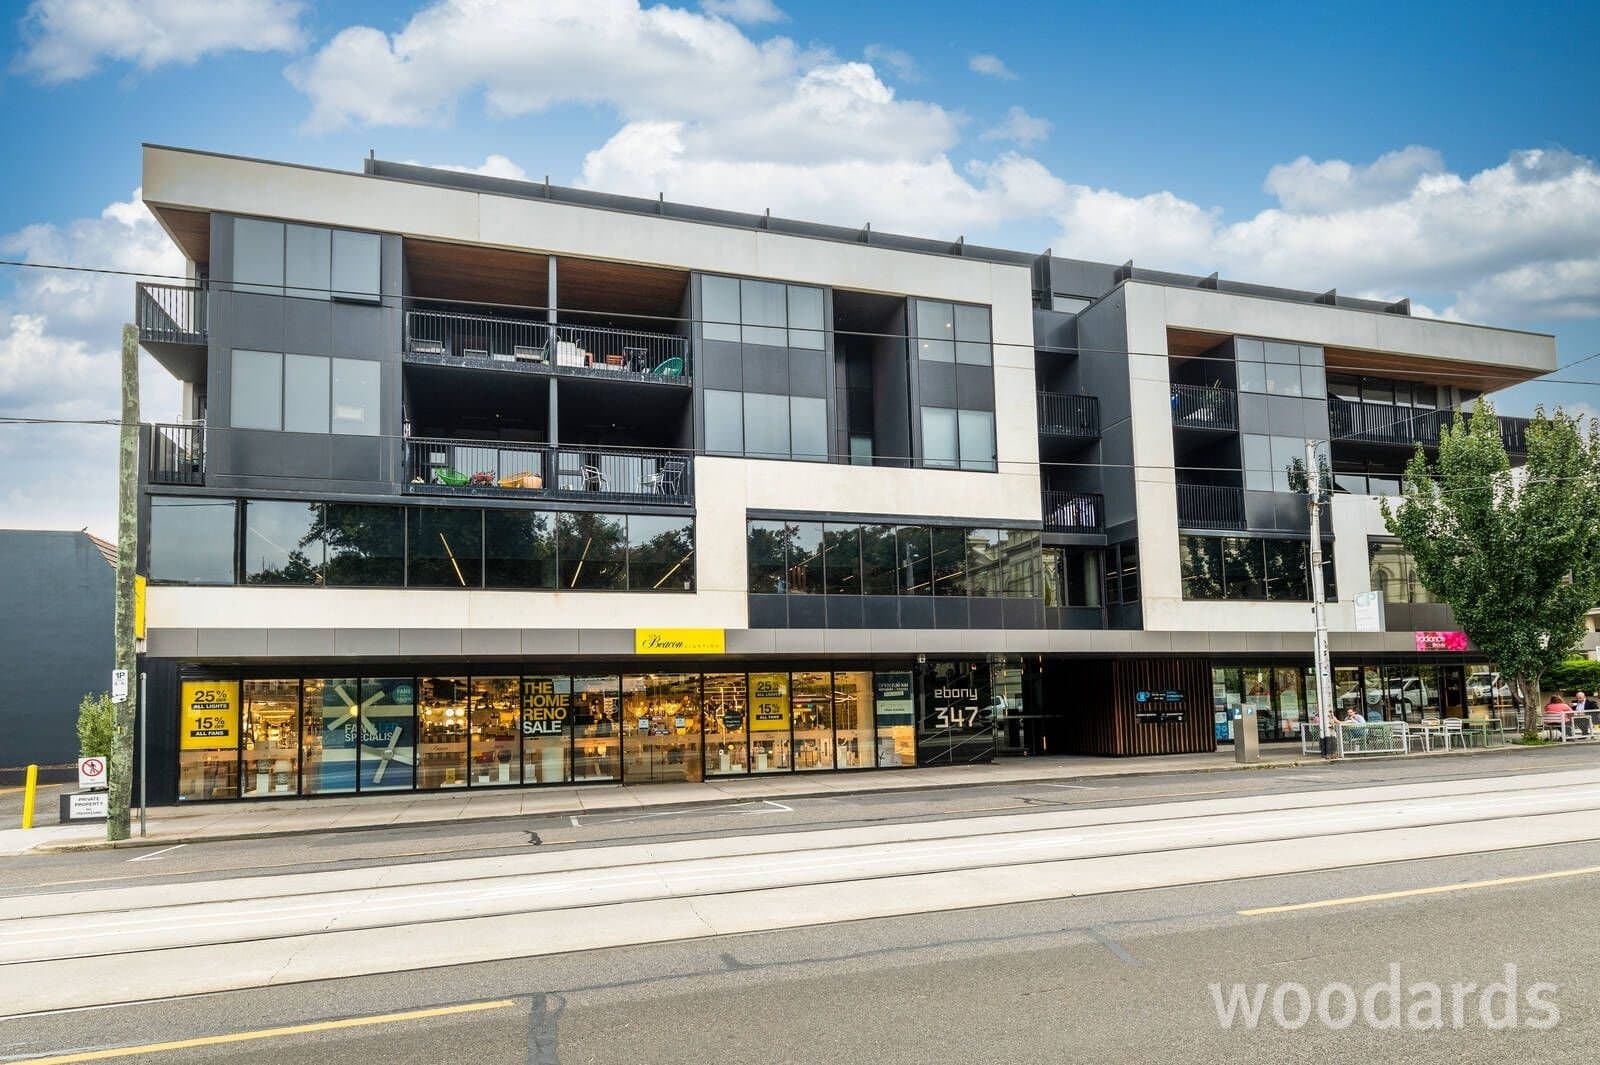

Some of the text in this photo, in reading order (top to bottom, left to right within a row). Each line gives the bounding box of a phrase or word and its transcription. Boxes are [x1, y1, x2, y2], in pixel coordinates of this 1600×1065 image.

[642, 634, 683, 649] Beacon
[523, 681, 553, 694] THE
[934, 686, 978, 701] ebony
[194, 689, 228, 703] 25%
[523, 694, 570, 708] HOME
[523, 708, 567, 720] RENO
[935, 706, 979, 728] 347
[195, 717, 225, 729] 15%
[523, 721, 562, 734] SALE
[344, 732, 393, 742] SPCIALIS
